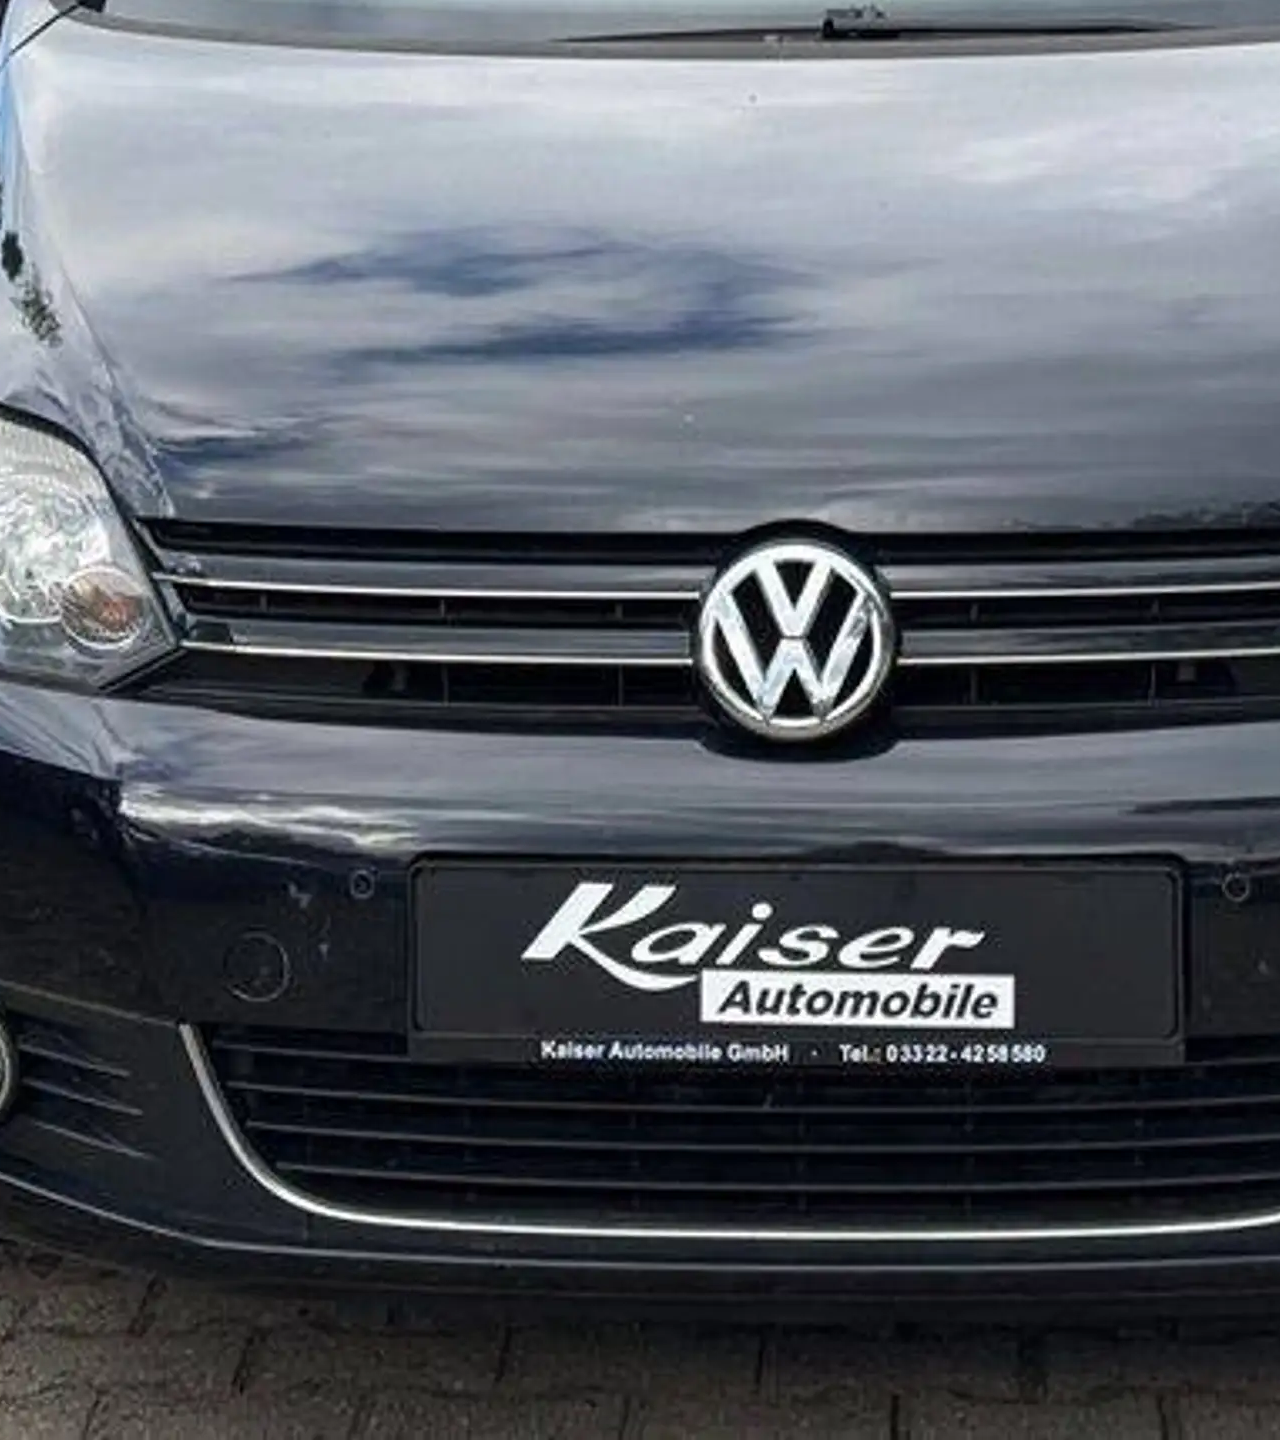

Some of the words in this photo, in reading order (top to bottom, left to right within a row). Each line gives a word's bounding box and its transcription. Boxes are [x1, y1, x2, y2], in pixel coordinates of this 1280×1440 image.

[521, 881, 985, 992] Kaiser
[717, 979, 999, 1021] Automobile
[539, 1040, 605, 1060] Kaiser
[607, 1040, 723, 1061] Automobile
[726, 1043, 790, 1062] GmbH
